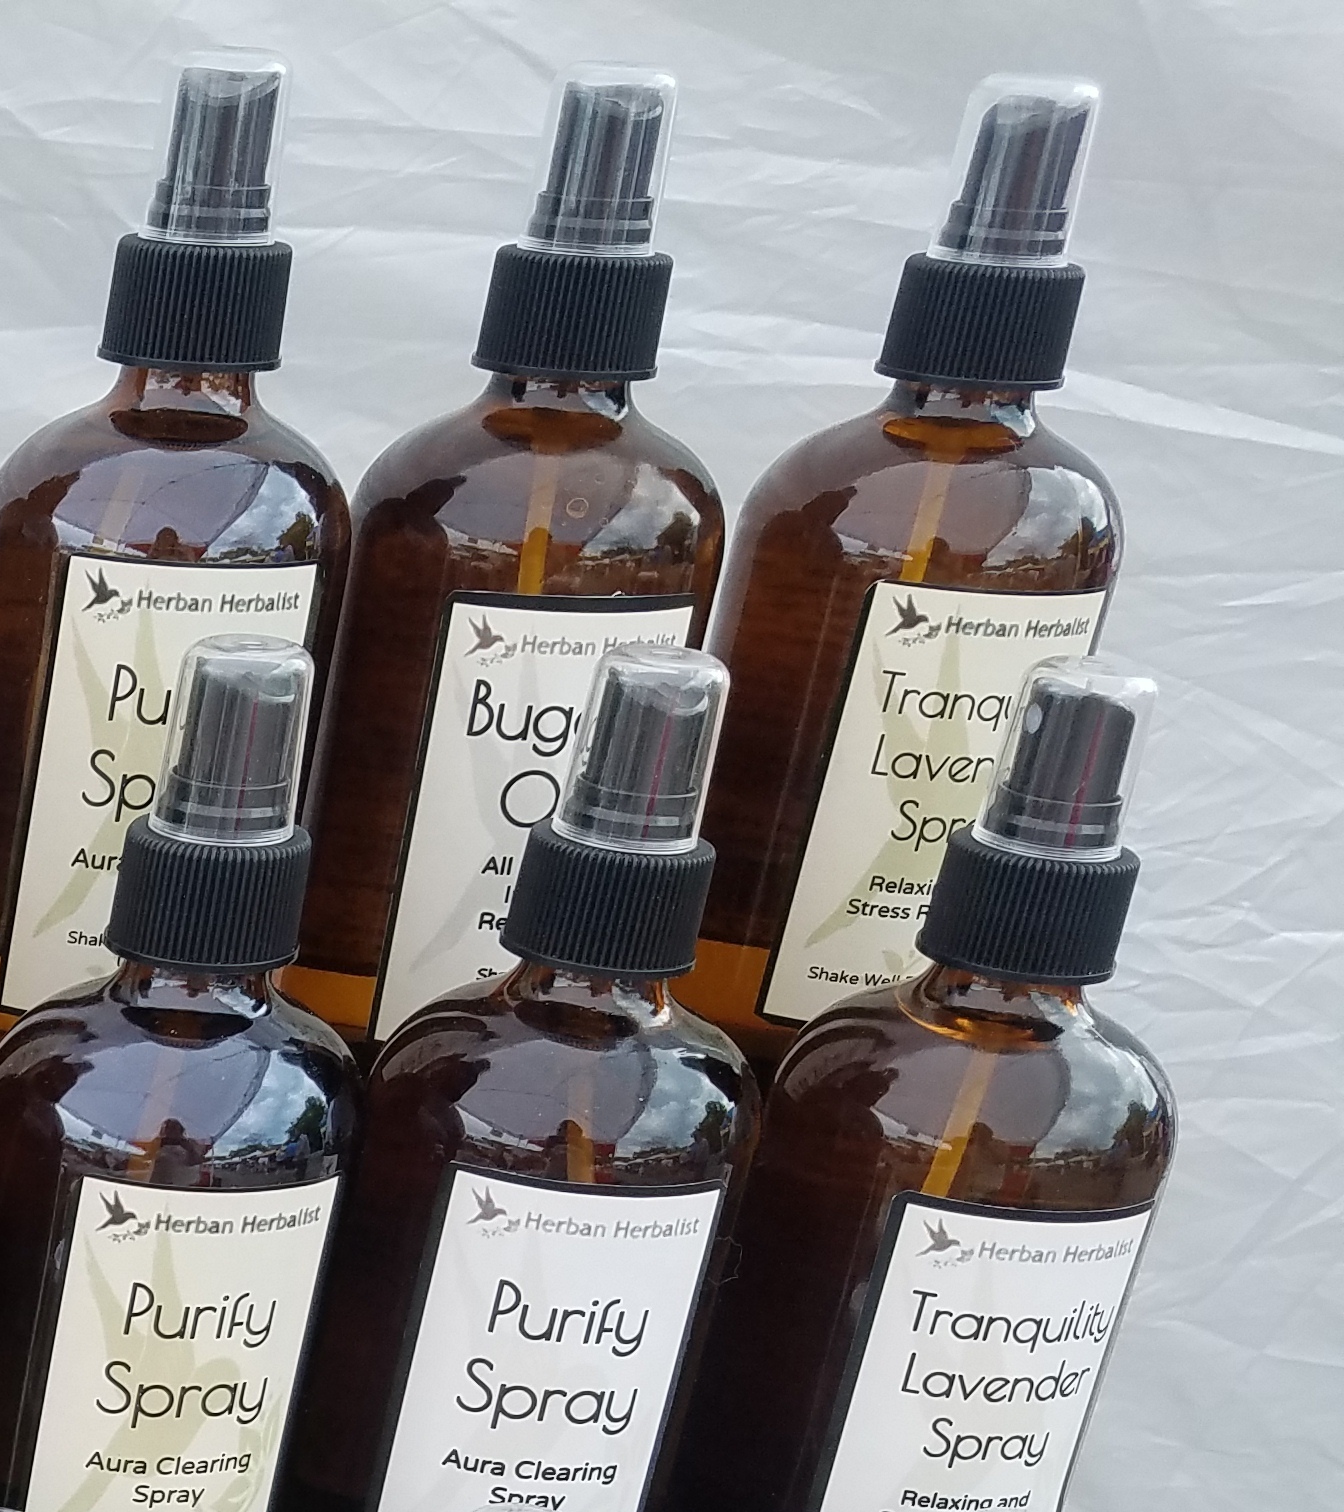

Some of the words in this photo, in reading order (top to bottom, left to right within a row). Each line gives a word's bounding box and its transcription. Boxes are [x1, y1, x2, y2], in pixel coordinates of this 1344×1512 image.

[137, 590, 211, 613] Herban
[220, 592, 299, 613] Herbalist
[944, 616, 1019, 638] Herban
[1025, 617, 1090, 639] Herbalist
[520, 635, 595, 656] Herban
[846, 899, 910, 920] Stress
[154, 1213, 233, 1235] Herban
[241, 1205, 321, 1235] Herbalist
[525, 1211, 606, 1238] Herban
[614, 1218, 699, 1239] Herbalist
[978, 1240, 1057, 1263] Herban
[1063, 1238, 1133, 1263] Herbalist
[123, 1282, 276, 1348] Purify
[488, 1279, 649, 1357] Purify
[912, 1289, 1115, 1353] Tranquility
[901, 1352, 1090, 1402] Lavender
[96, 1361, 268, 1428] Spray
[456, 1358, 638, 1435] Spray
[923, 1417, 1050, 1468] Spray
[85, 1451, 147, 1475] Aura
[156, 1452, 251, 1476] Clearing
[132, 1484, 205, 1508] Spray
